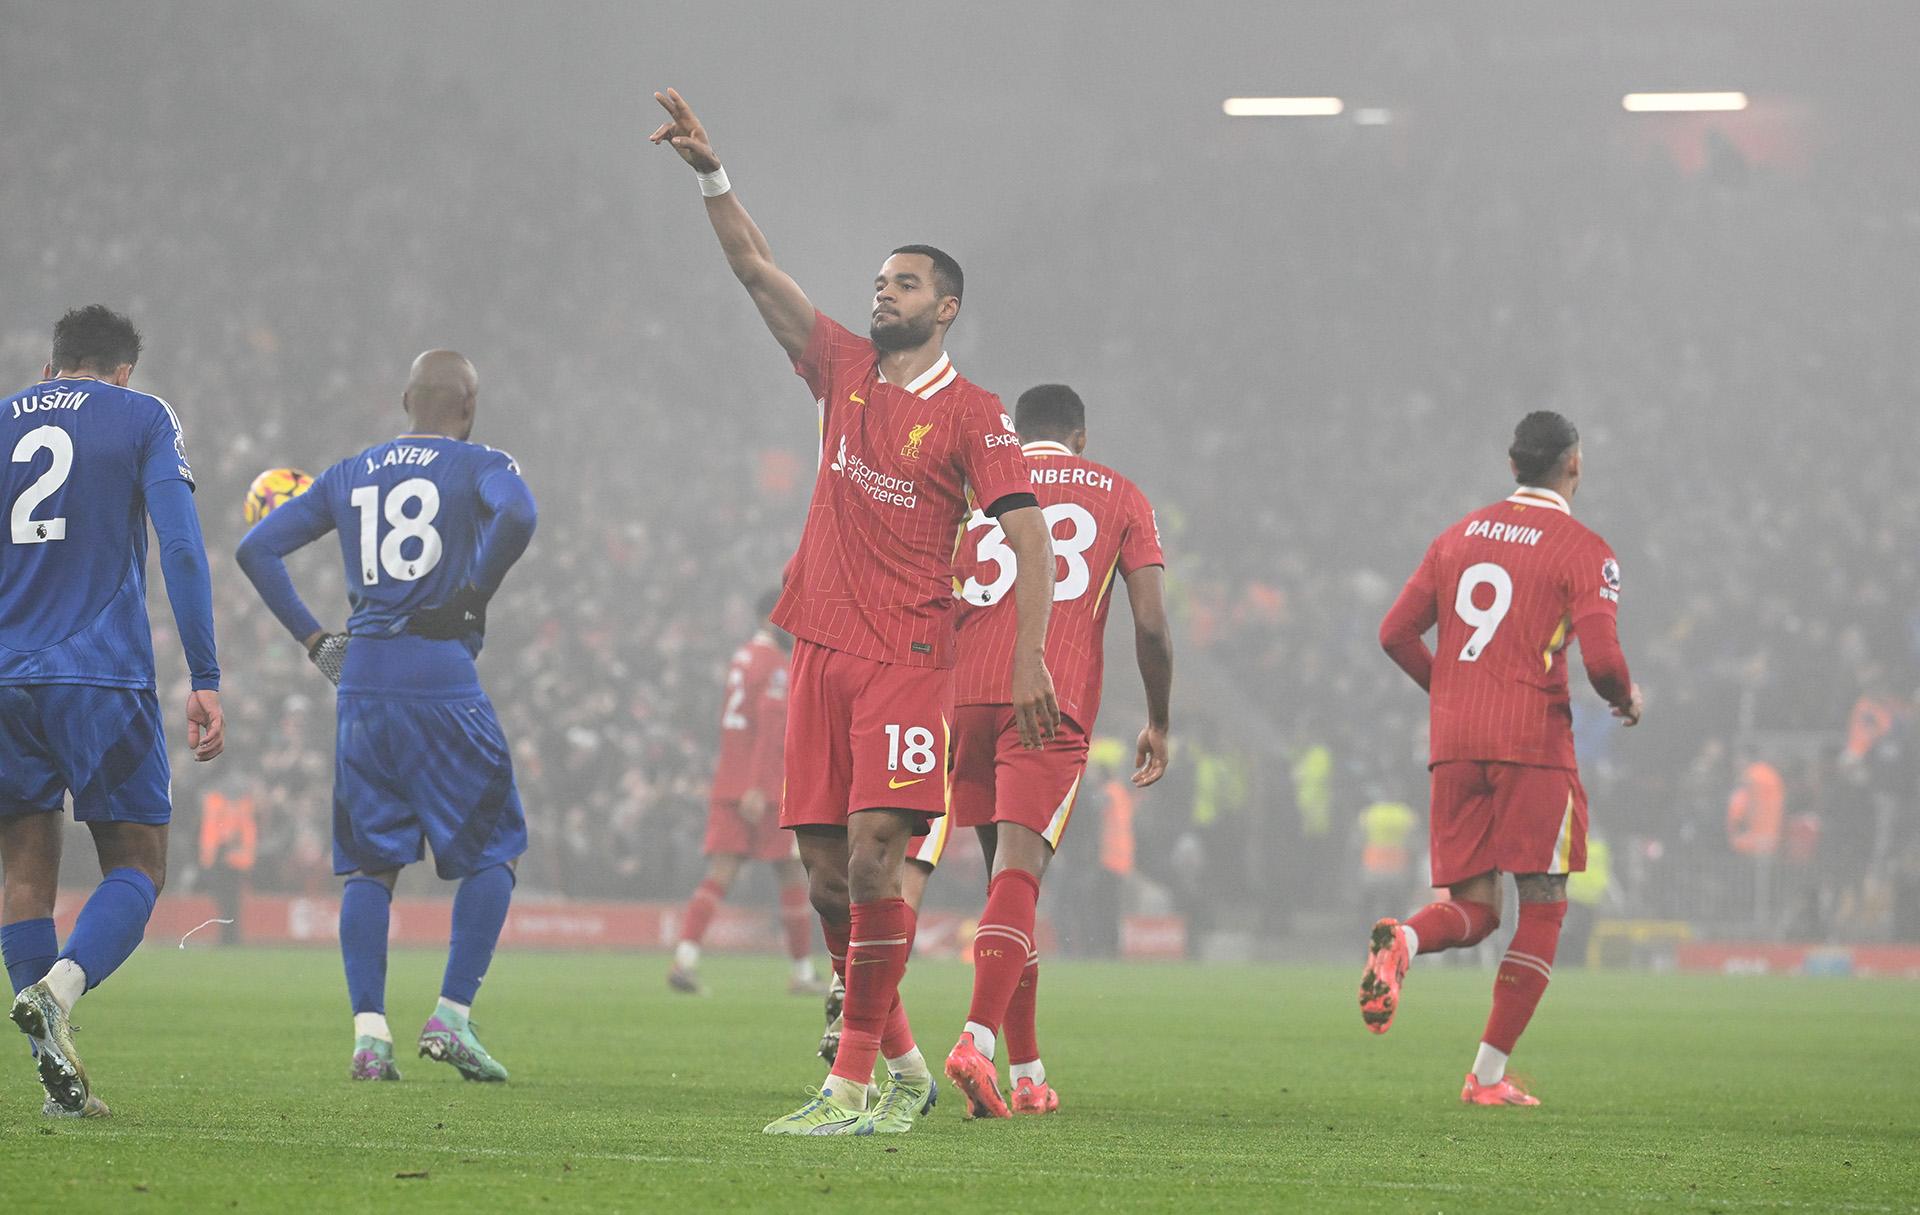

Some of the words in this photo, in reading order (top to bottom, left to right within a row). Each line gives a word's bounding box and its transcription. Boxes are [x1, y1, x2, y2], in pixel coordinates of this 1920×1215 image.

[12, 391, 90, 419] JUSTIN
[366, 457, 381, 474] J.
[383, 447, 440, 467] AYEW
[900, 446, 919, 460] LFC
[984, 433, 1021, 449] Expe
[11, 424, 74, 544] 2
[847, 466, 917, 509] chartered
[848, 454, 915, 494] standard
[1030, 468, 1113, 492] NBERCH
[351, 477, 443, 586] 18
[1464, 520, 1544, 546] DARWIN
[961, 502, 1098, 607] 38
[1455, 562, 1513, 662] 9
[722, 668, 748, 730] 2
[885, 724, 936, 774] 18
[980, 948, 1003, 958] LFC
